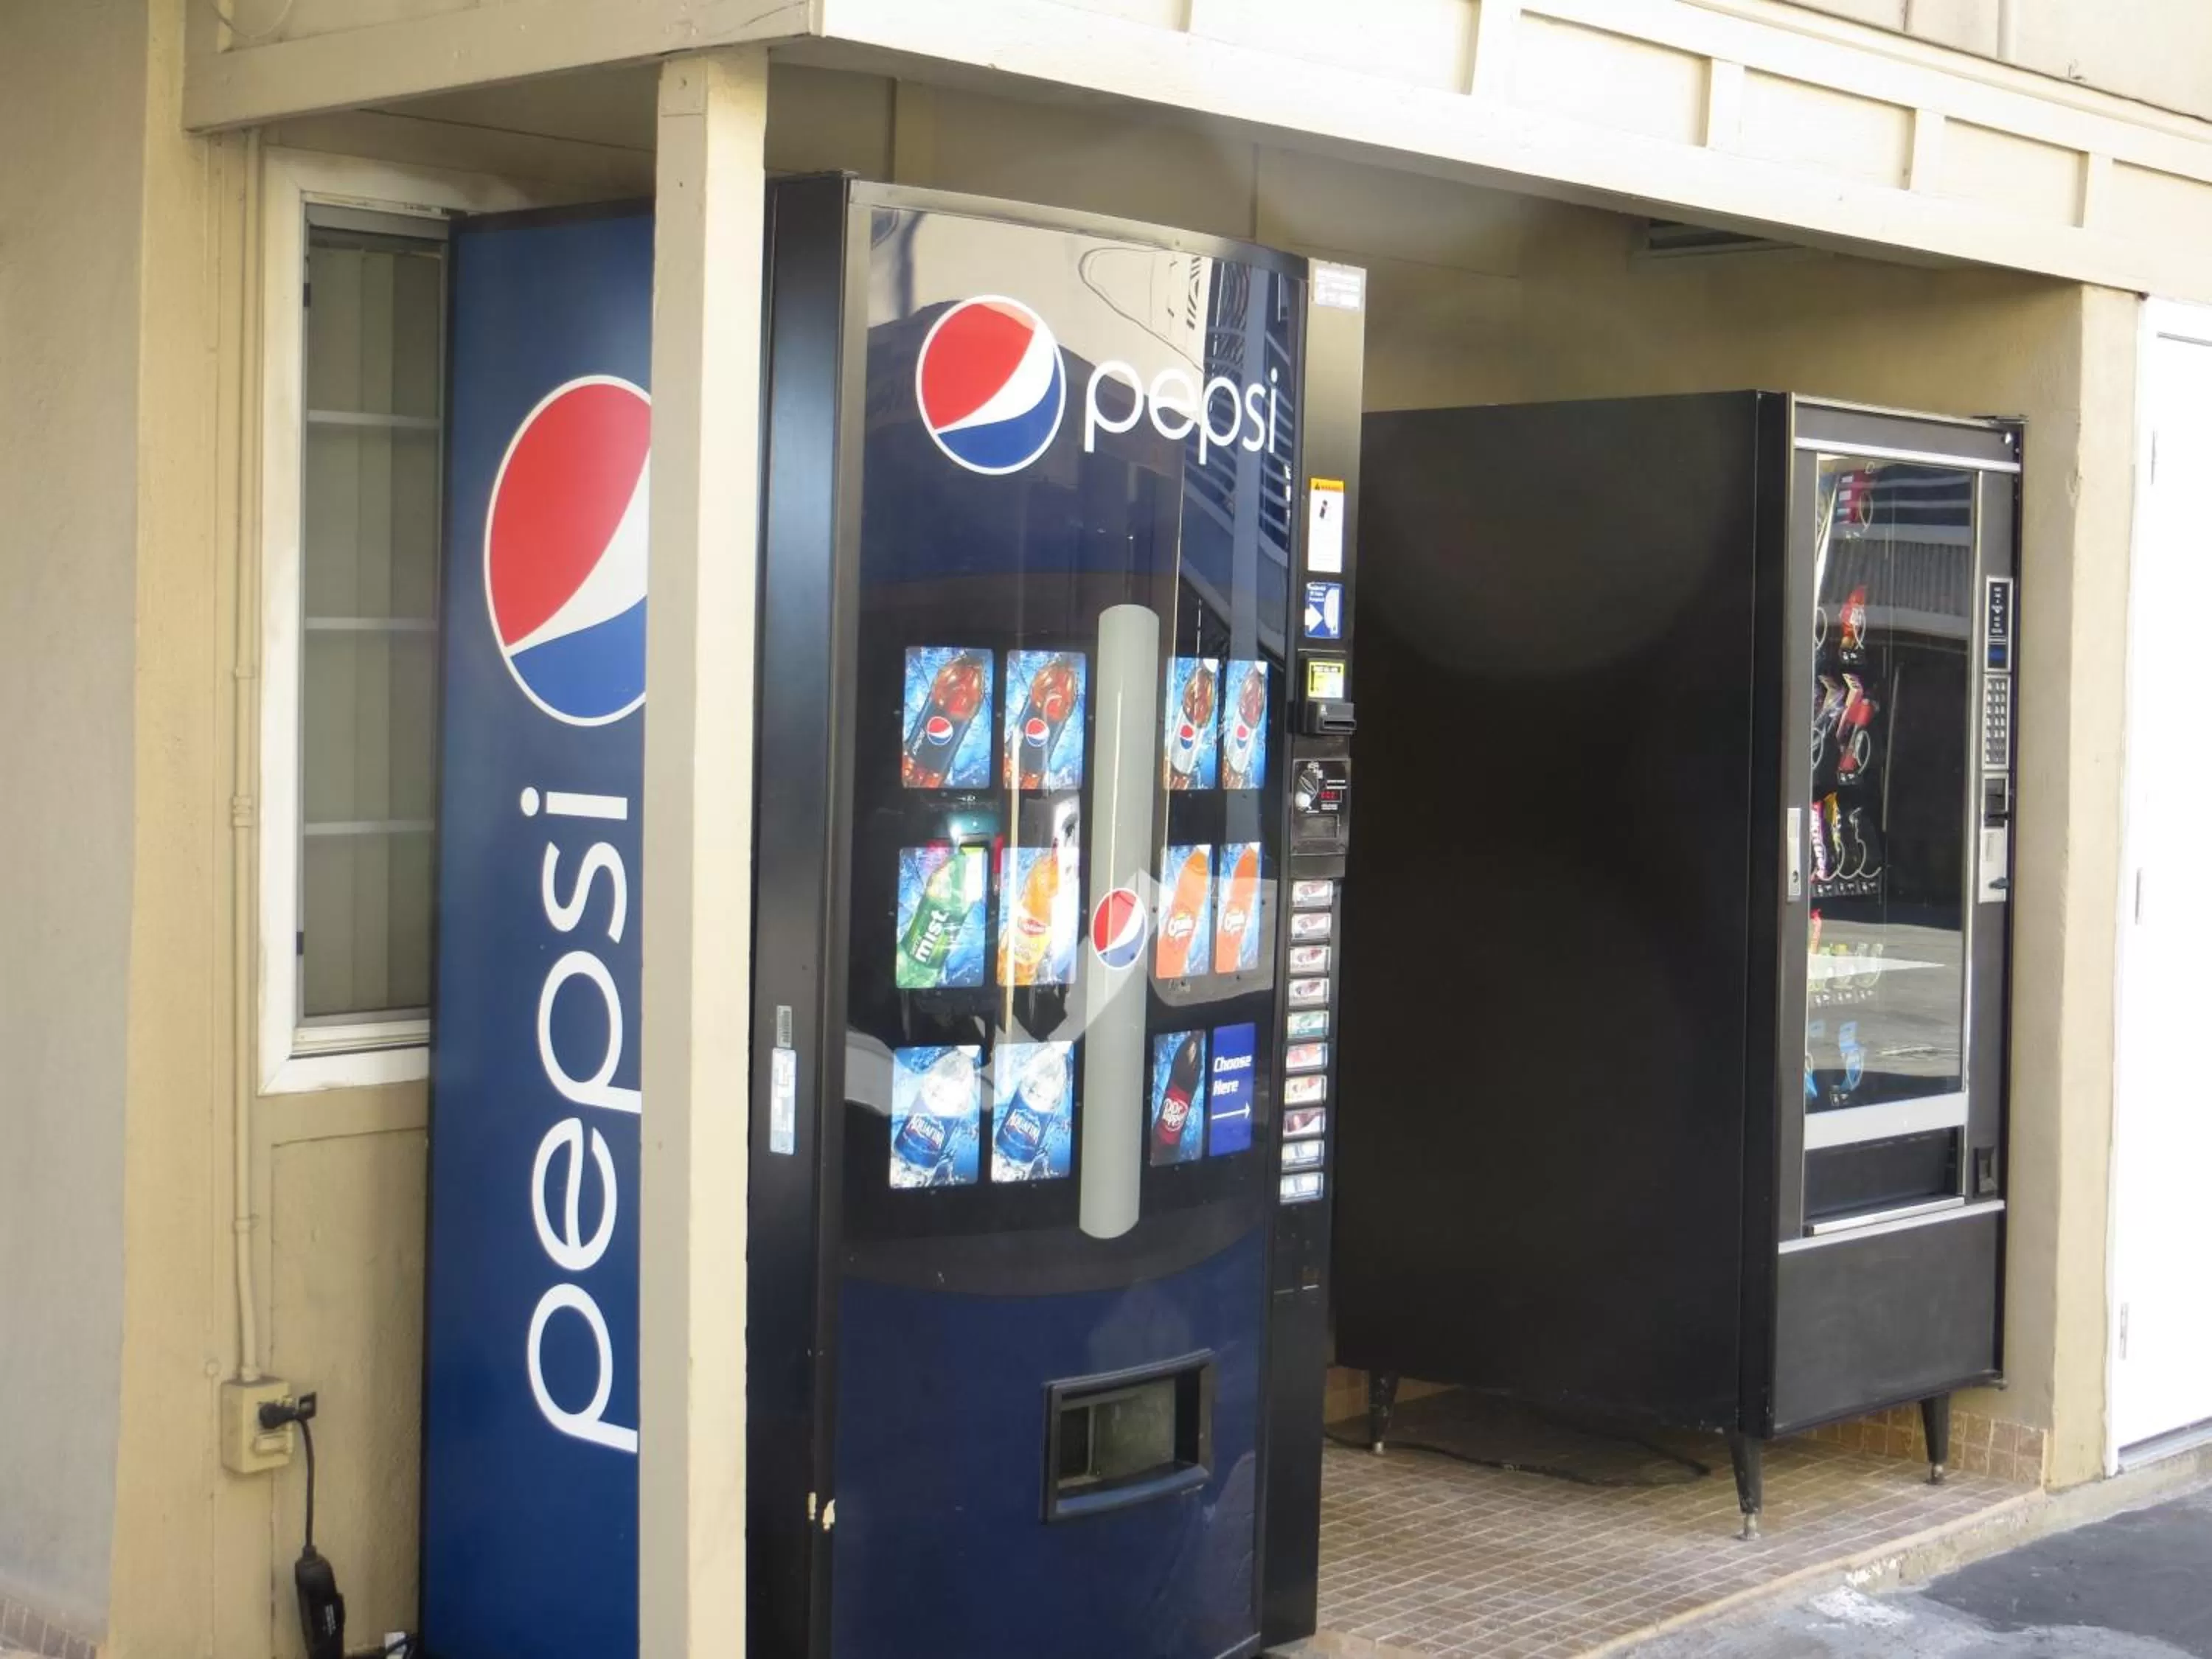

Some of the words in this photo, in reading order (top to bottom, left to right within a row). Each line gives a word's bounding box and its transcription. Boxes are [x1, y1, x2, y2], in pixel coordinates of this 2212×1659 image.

[1083, 360, 1278, 465] pepsi
[915, 910, 950, 963] mist
[1212, 1079, 1239, 1096] Here
[1213, 1054, 1252, 1073] Choose
[520, 786, 642, 1453] pepsi
